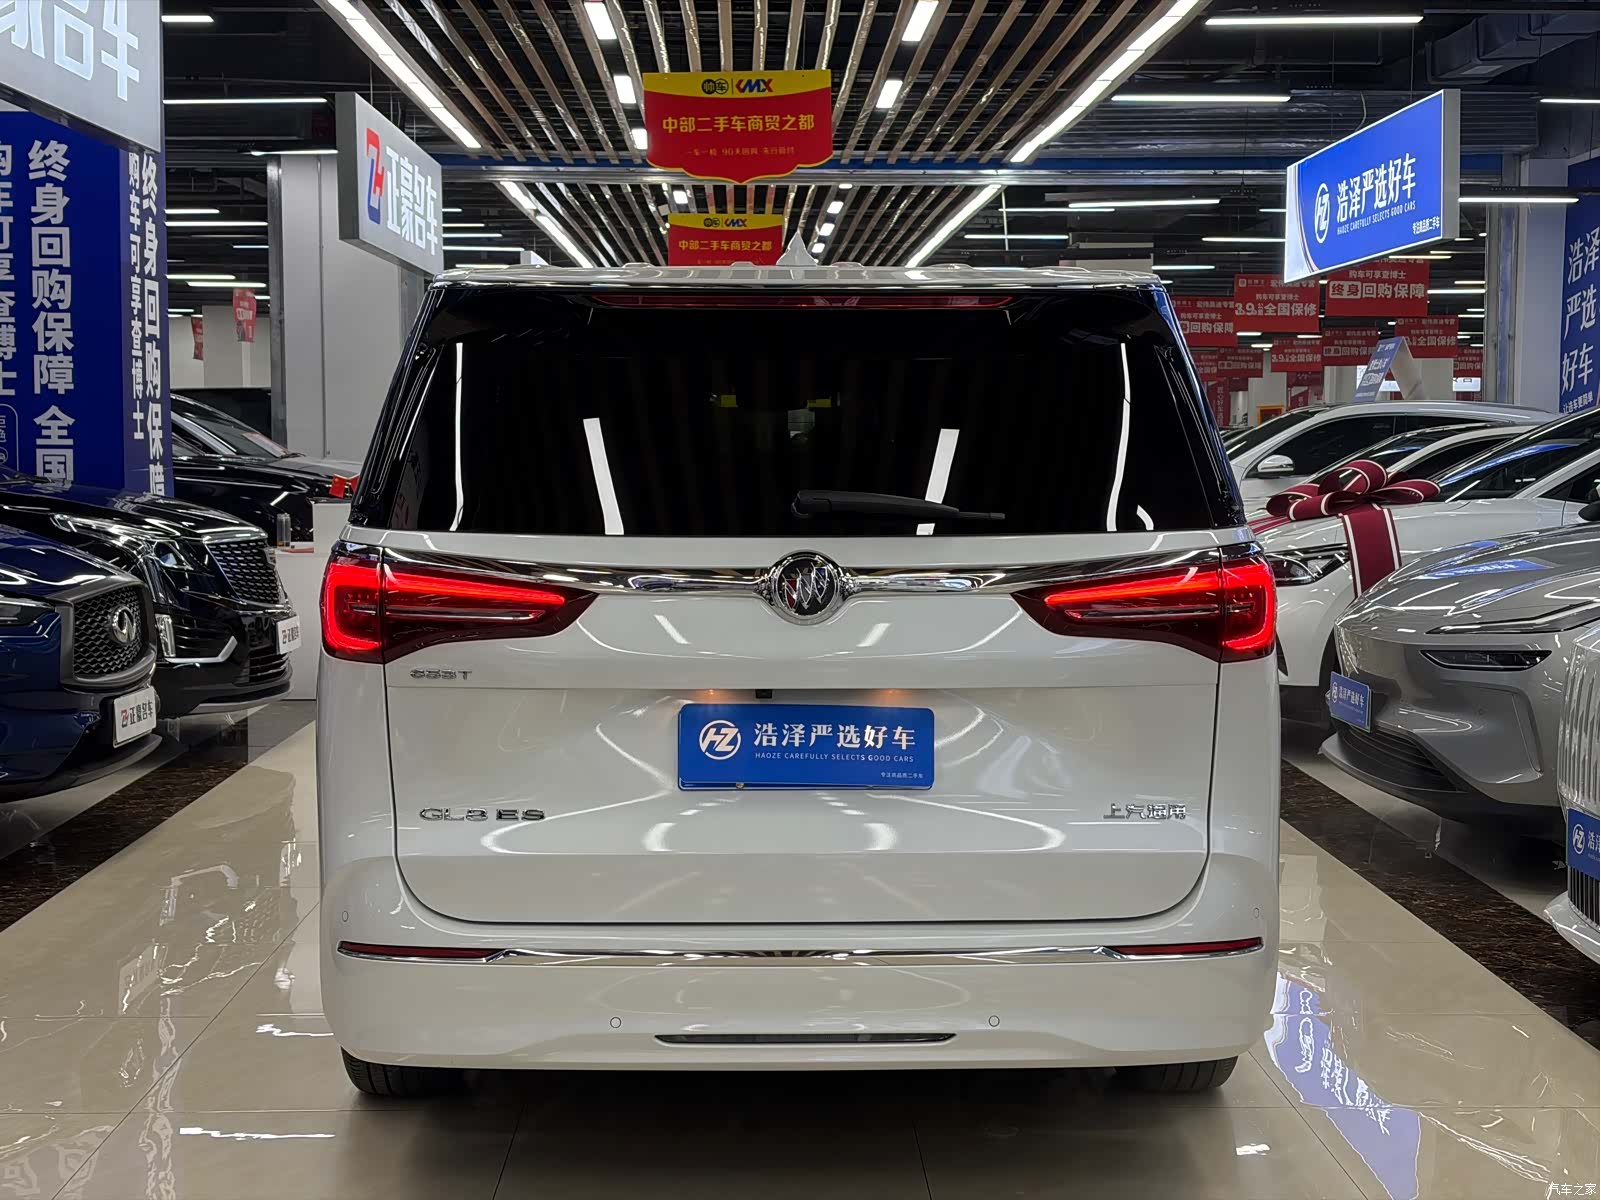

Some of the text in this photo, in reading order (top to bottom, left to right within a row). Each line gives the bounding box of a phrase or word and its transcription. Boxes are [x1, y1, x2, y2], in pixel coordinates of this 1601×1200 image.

[662, 114, 814, 133] 中部二手车商贸之都
[386, 146, 438, 256] 正豪名车
[1337, 153, 1416, 223] 浩泽严选好车
[1350, 216, 1372, 231] CAREFULLY
[1372, 209, 1390, 224] SELECTS
[1391, 204, 1403, 216] GOOD
[679, 240, 772, 251] 中部二手车商贸之都
[28, 140, 74, 395] 终身回购保障
[1349, 270, 1406, 279] 购车可享查博士
[128, 152, 145, 440] 购车可享查博士
[1331, 283, 1425, 299] 终身回购保障
[1564, 284, 1597, 341] 严选
[1561, 343, 1594, 395] 好车
[754, 723, 916, 749] 浩泽严选好车
[419, 808, 546, 821] GL8 ES
[1103, 803, 1186, 820] 上汽通用
